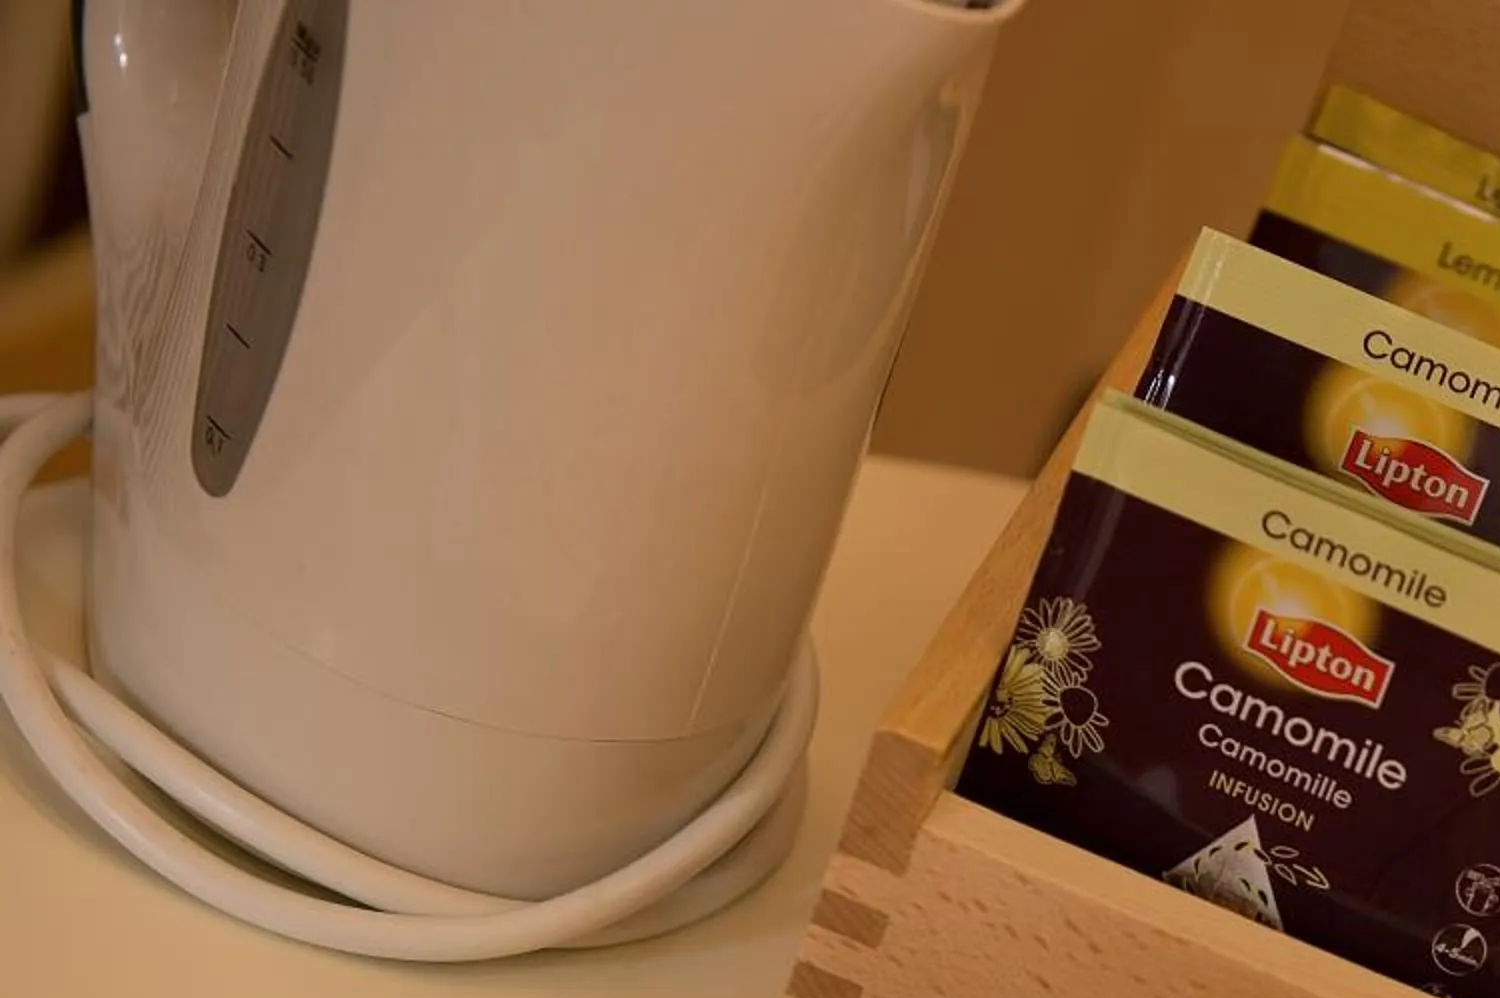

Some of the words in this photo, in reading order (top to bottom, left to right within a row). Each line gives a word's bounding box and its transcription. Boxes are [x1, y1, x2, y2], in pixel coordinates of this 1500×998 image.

[1353, 439, 1469, 510] Lipton
[1261, 510, 1447, 609] Camomile
[1257, 618, 1376, 693] Lipton
[1174, 661, 1407, 790] Camomile
[1198, 724, 1352, 810] Camomille
[1209, 769, 1315, 832] INFUSION
